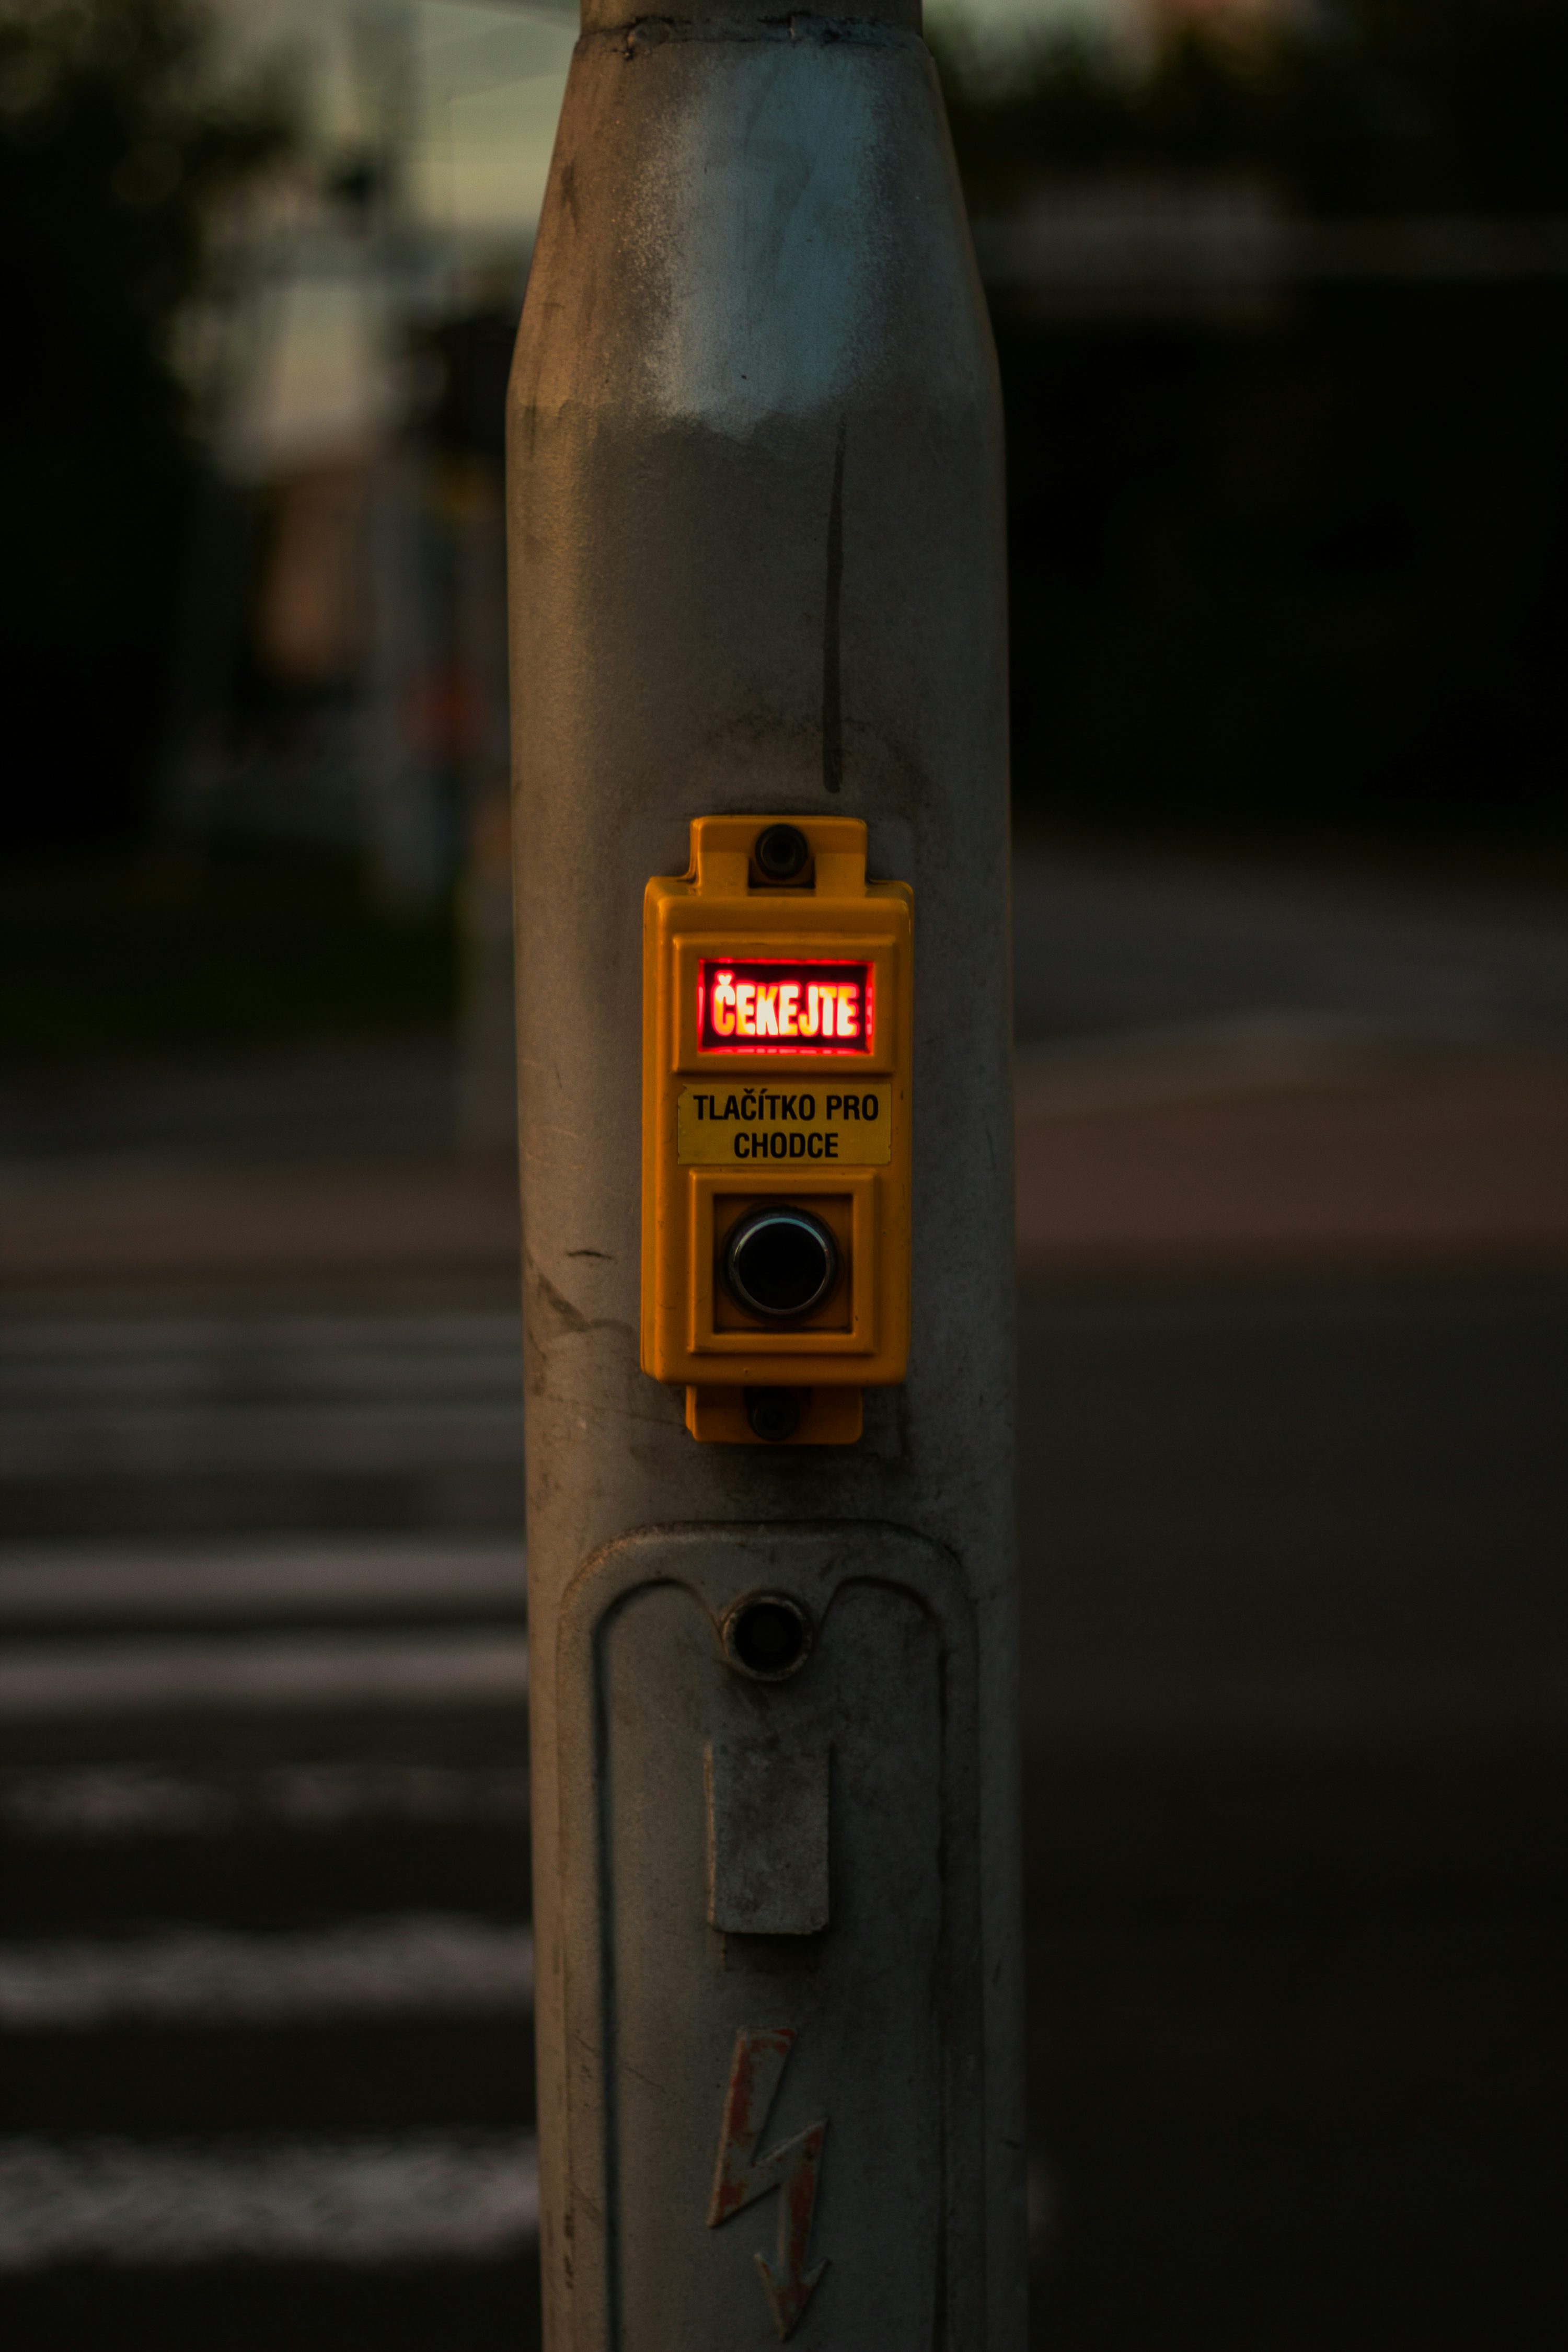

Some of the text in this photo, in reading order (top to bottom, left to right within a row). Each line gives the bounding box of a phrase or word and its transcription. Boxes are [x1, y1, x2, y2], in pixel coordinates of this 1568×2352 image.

[713, 972, 859, 1036] ČEKEJTE
[693, 1088, 879, 1121] TLAČÍTKO PRO
[734, 1132, 838, 1158] CHODCE
